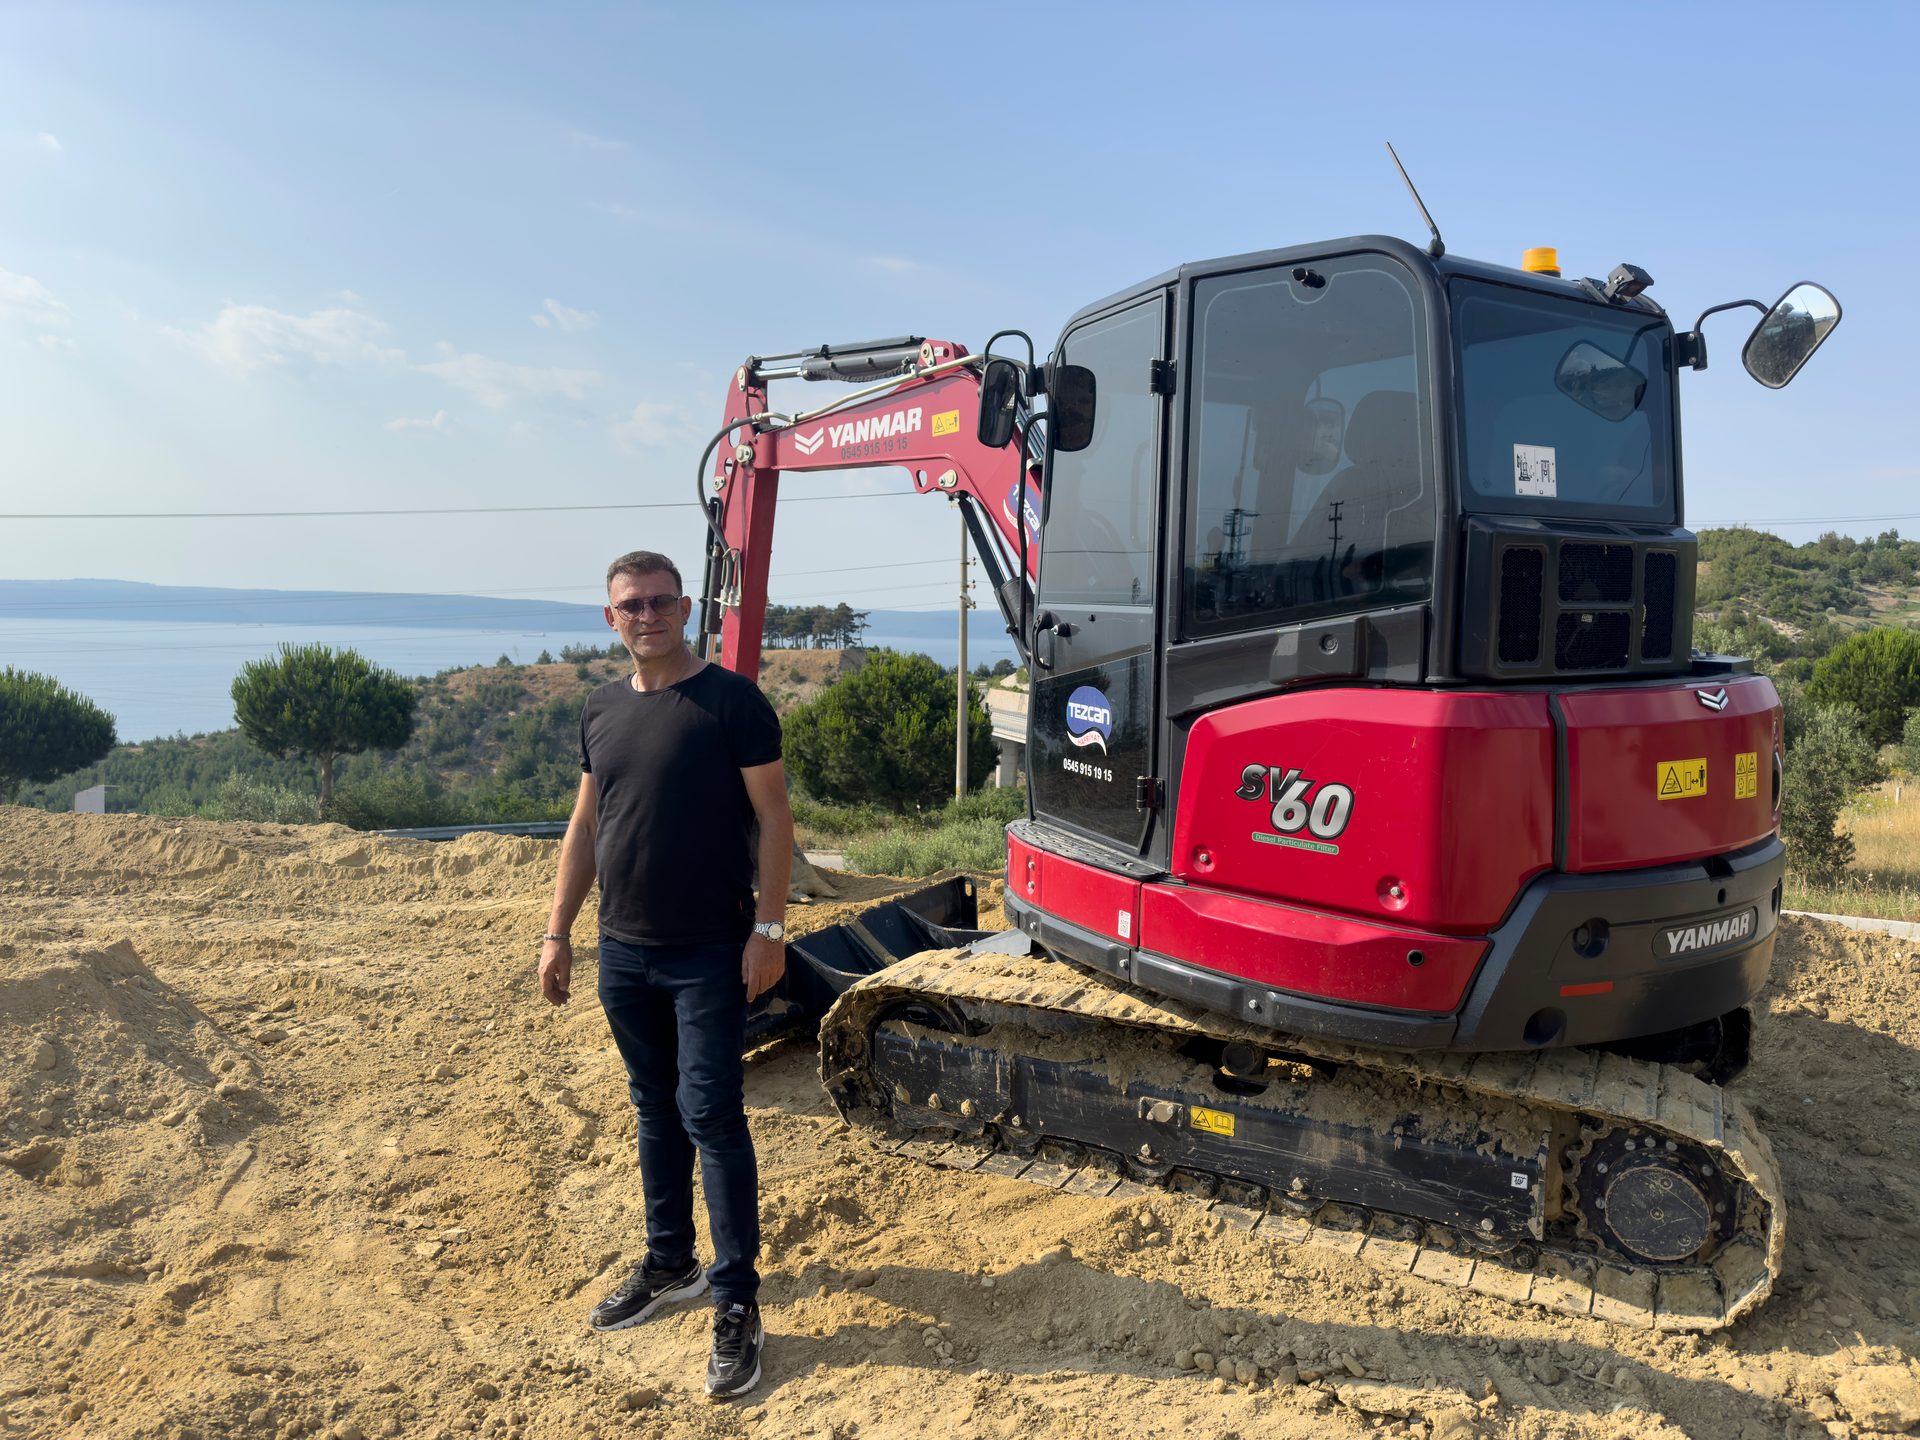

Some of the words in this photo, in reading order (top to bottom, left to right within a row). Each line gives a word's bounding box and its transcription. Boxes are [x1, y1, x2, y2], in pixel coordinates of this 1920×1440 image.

[828, 406, 923, 449] YANMAR
[840, 445, 862, 460] 0545
[864, 441, 880, 456] 915
[883, 439, 894, 453] 19
[897, 437, 908, 450] 15
[1063, 758, 1079, 773] 0545
[1079, 763, 1093, 777] 915
[1093, 766, 1102, 780] 19
[1103, 769, 1113, 783] 15
[1255, 833, 1276, 843] Diesel
[1277, 837, 1315, 850] Particulate
[1316, 844, 1336, 854] Filter
[1667, 911, 1750, 954] YANMAR
